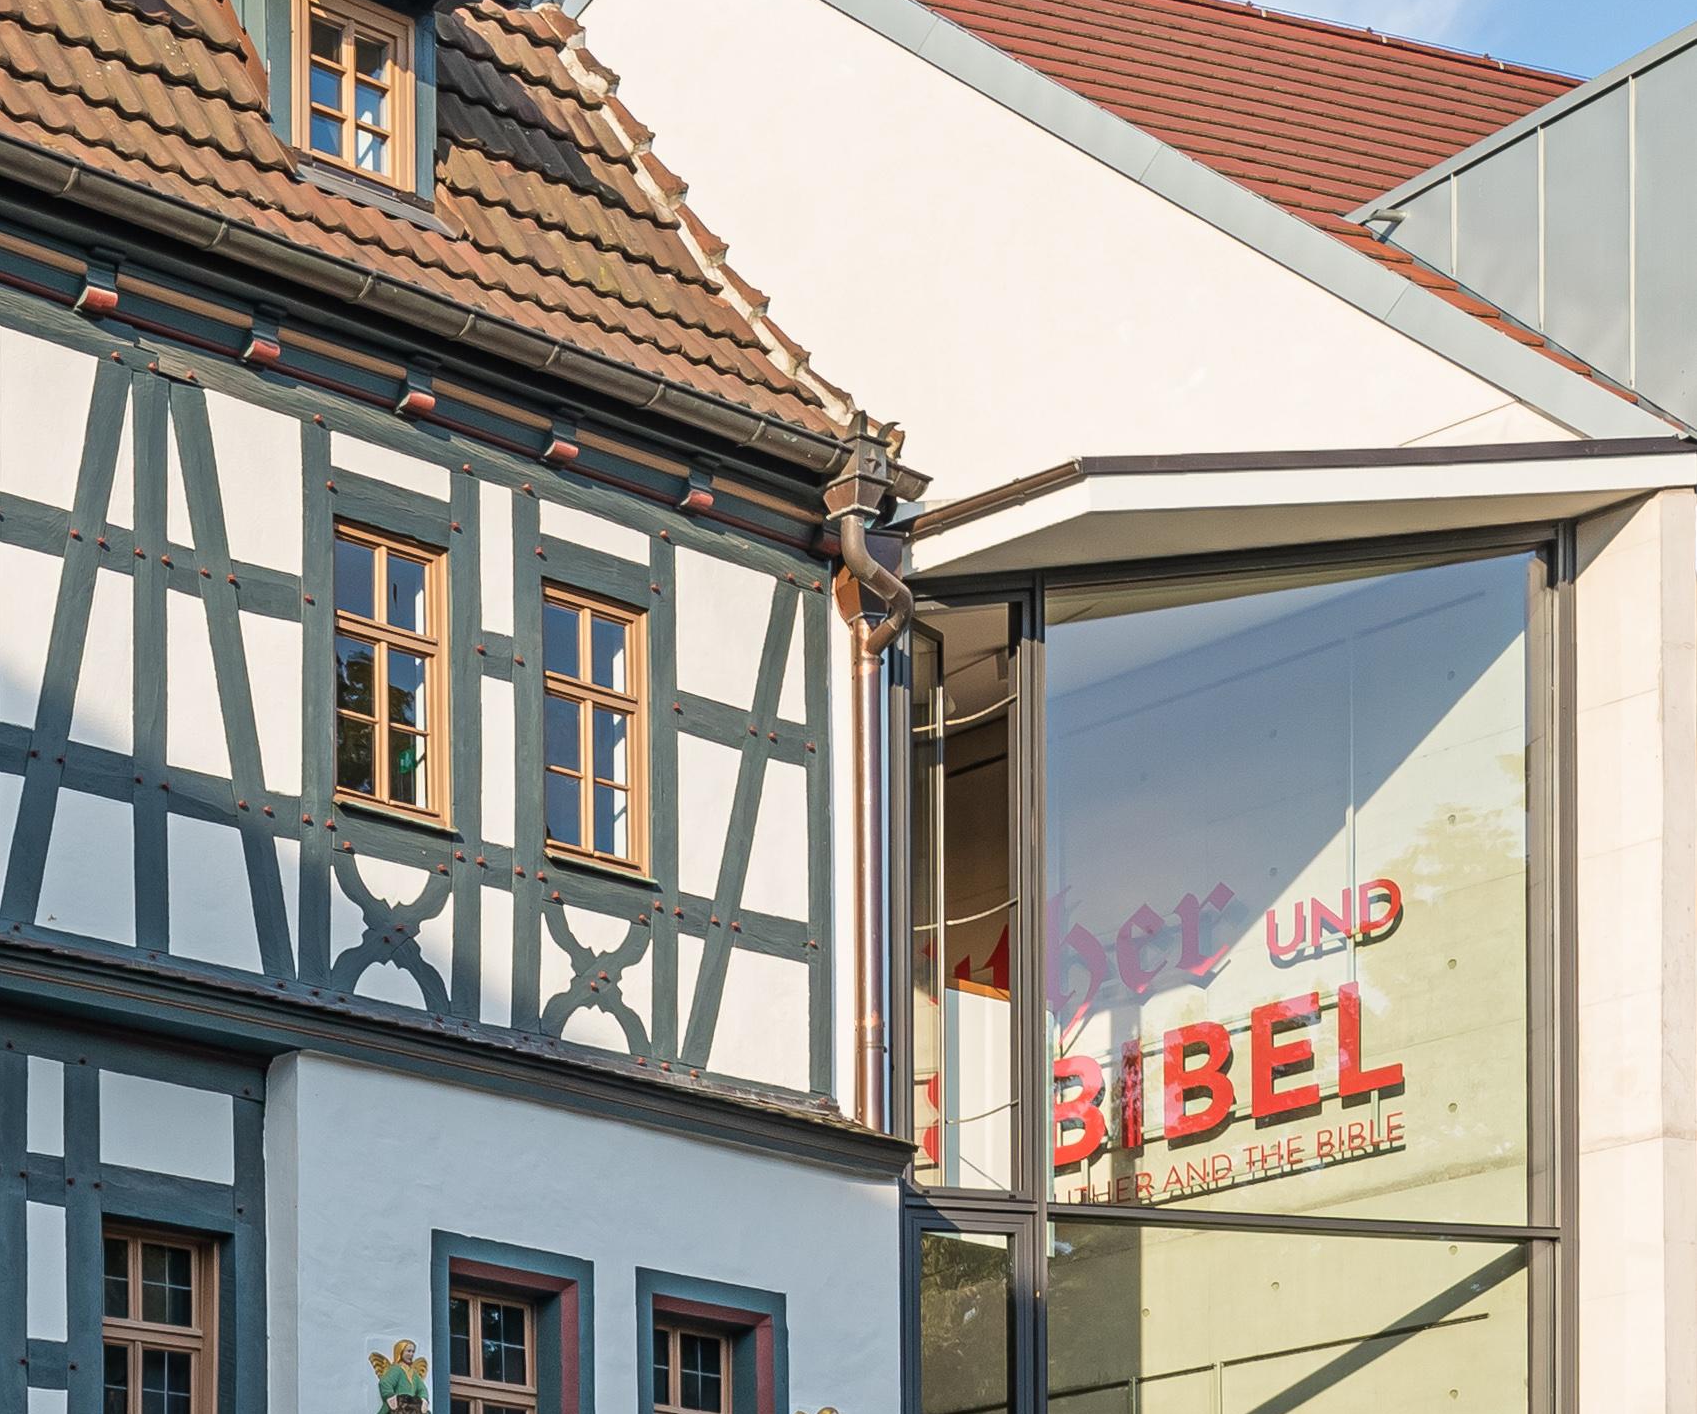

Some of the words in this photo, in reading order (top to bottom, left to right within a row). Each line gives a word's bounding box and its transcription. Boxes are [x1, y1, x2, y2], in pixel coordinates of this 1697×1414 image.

[1266, 878, 1401, 955] UND
[1053, 980, 1404, 1167] BIBEL
[1163, 1153, 1232, 1192] AND
[1243, 1135, 1304, 1174] THE
[1316, 1112, 1404, 1158] BIBLE
